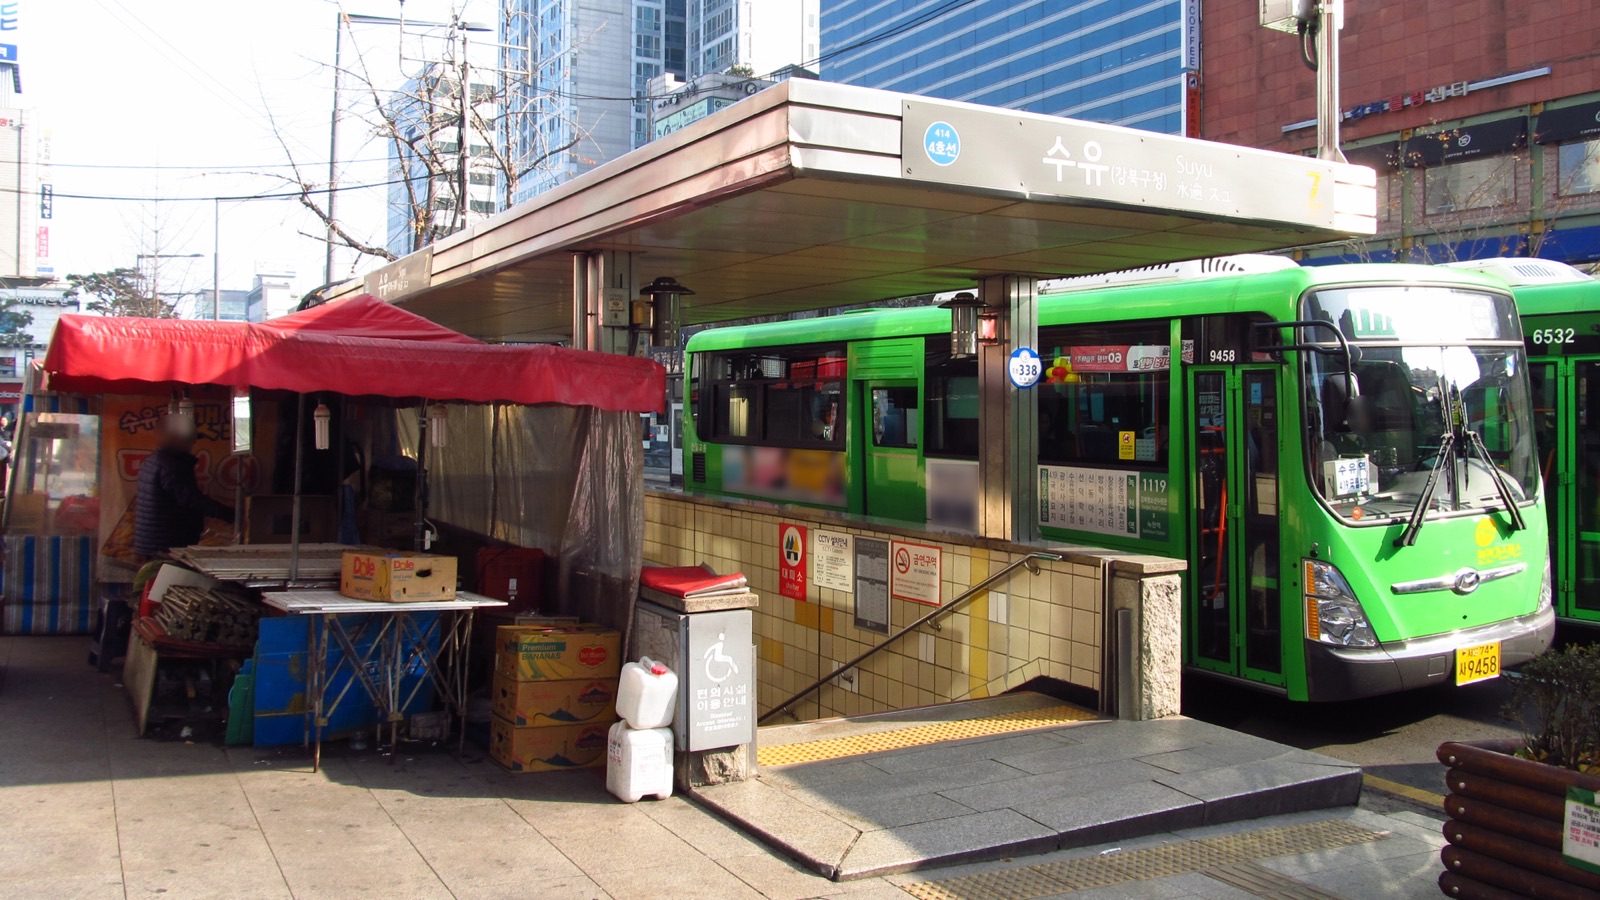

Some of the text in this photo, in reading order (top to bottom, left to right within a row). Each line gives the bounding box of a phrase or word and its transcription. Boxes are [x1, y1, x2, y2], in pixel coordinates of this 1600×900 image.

[935, 128, 950, 138] 414
[928, 141, 957, 158] 4호선
[1042, 136, 1167, 191] 수유 (강북구청)
[1176, 155, 1213, 181] Suyu
[1306, 171, 1321, 199] 7
[1533, 328, 1574, 344] 6532
[1210, 350, 1235, 362] 9458
[1019, 364, 1037, 376] 338
[1338, 461, 1367, 476] 수유역
[1142, 479, 1167, 493] 1119
[818, 534, 831, 544] CCTV
[353, 556, 375, 577] Dole
[393, 560, 414, 570] Dole
[914, 553, 937, 568] 금연구역
[781, 567, 803, 583] 대피소
[522, 644, 556, 652] Premium
[521, 652, 561, 661] BANANAS
[697, 695, 747, 710] 이용안내
